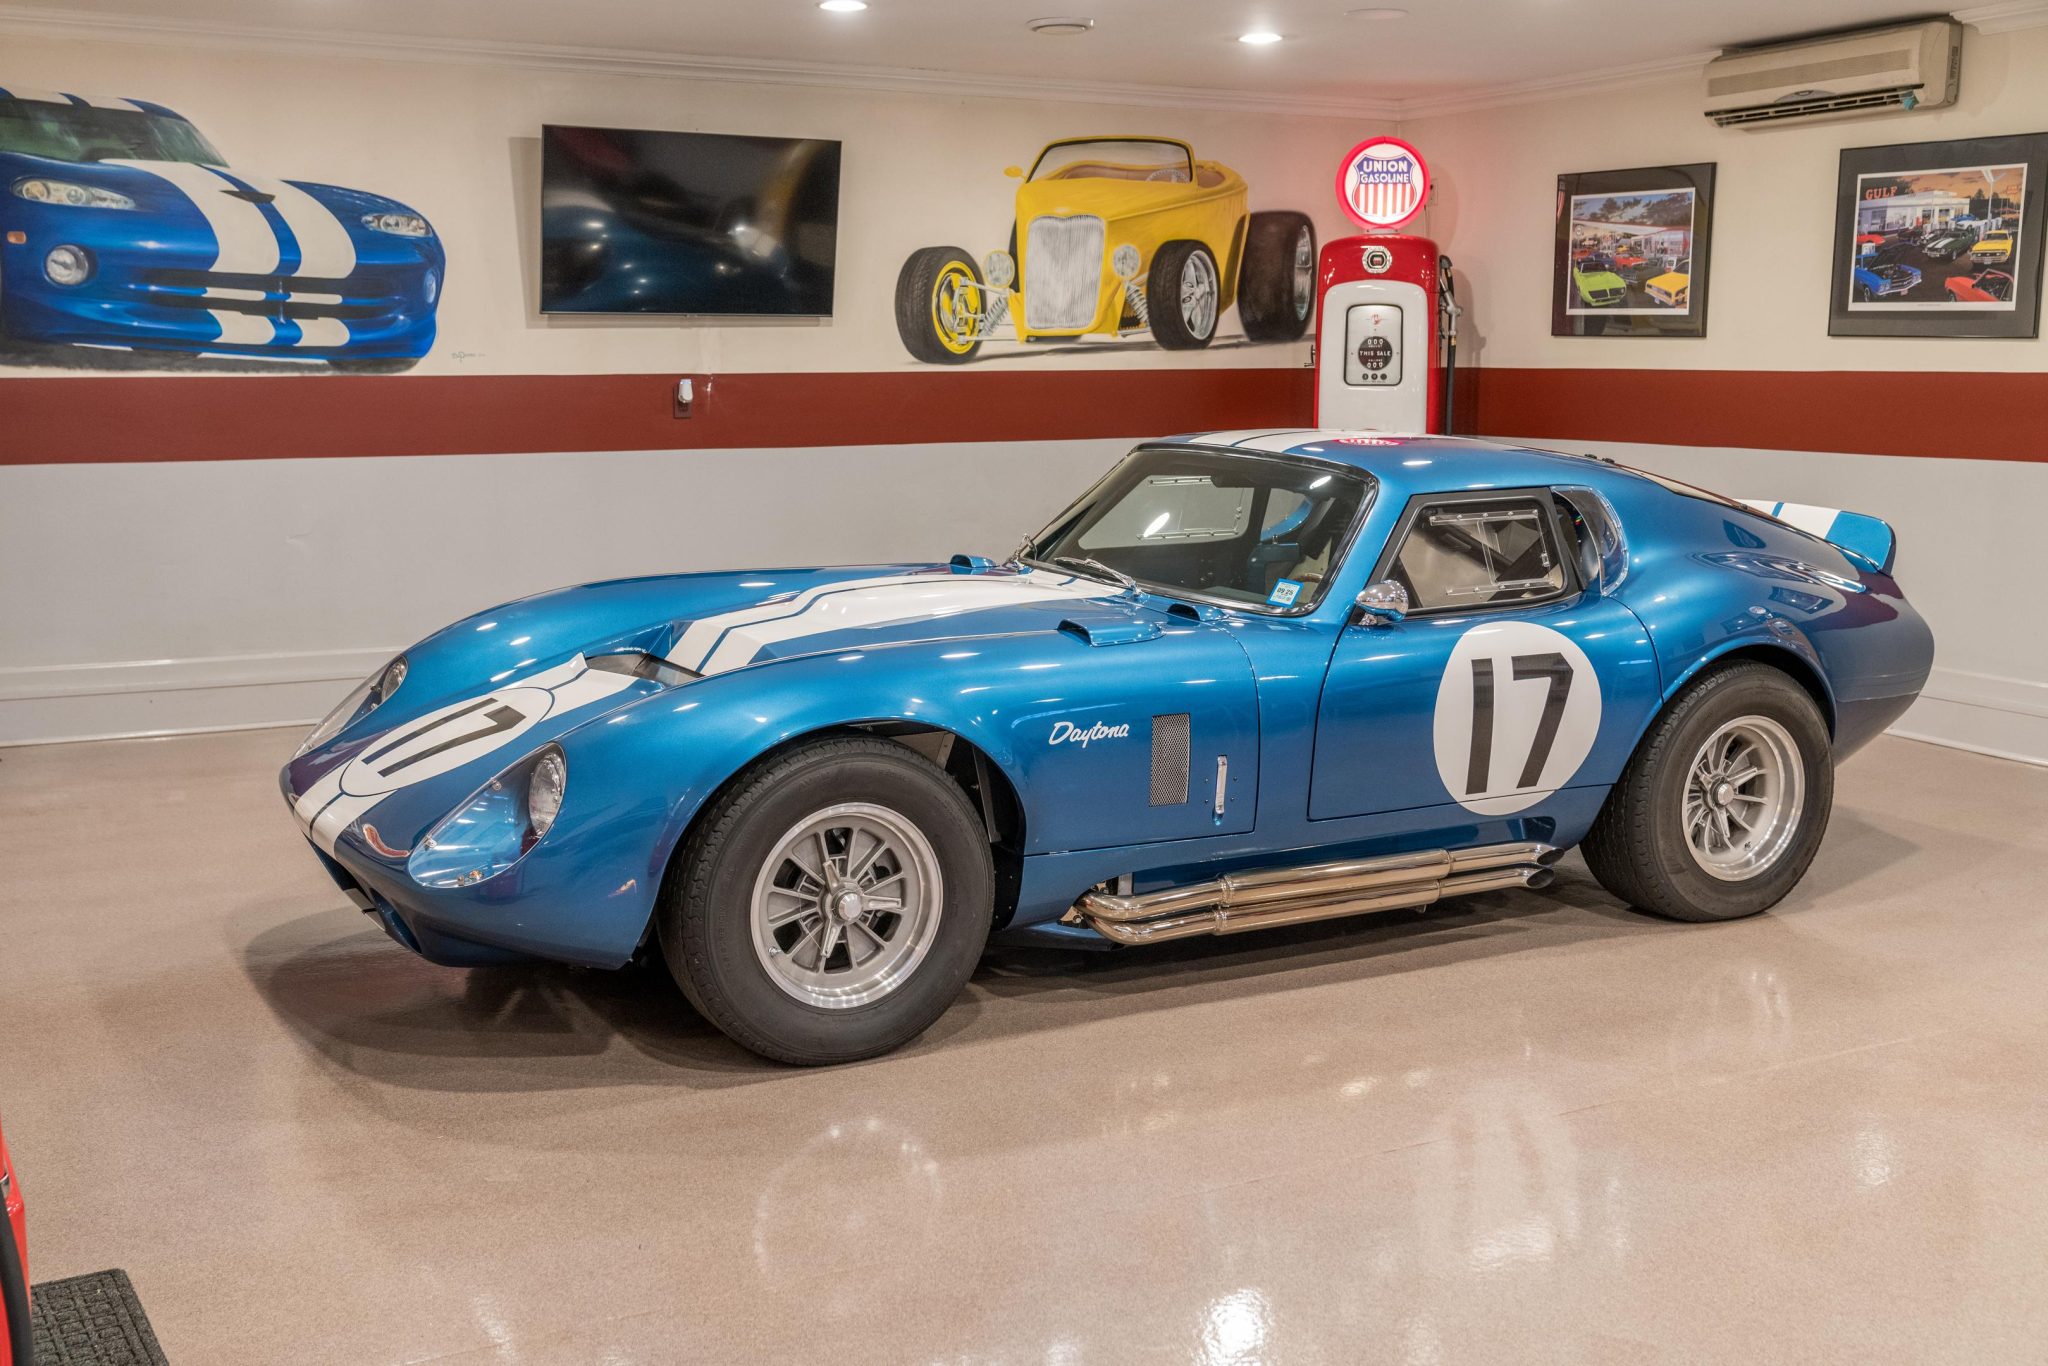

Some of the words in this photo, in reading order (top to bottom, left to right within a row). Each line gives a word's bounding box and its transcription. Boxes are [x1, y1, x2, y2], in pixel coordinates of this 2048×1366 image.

[1363, 161, 1408, 172] UNION
[1361, 173, 1409, 183] GASOLINE
[1865, 185, 1898, 201] GULF
[1048, 720, 1130, 749] Daytona
[1465, 652, 1574, 795] 17
[361, 697, 527, 778] 17
